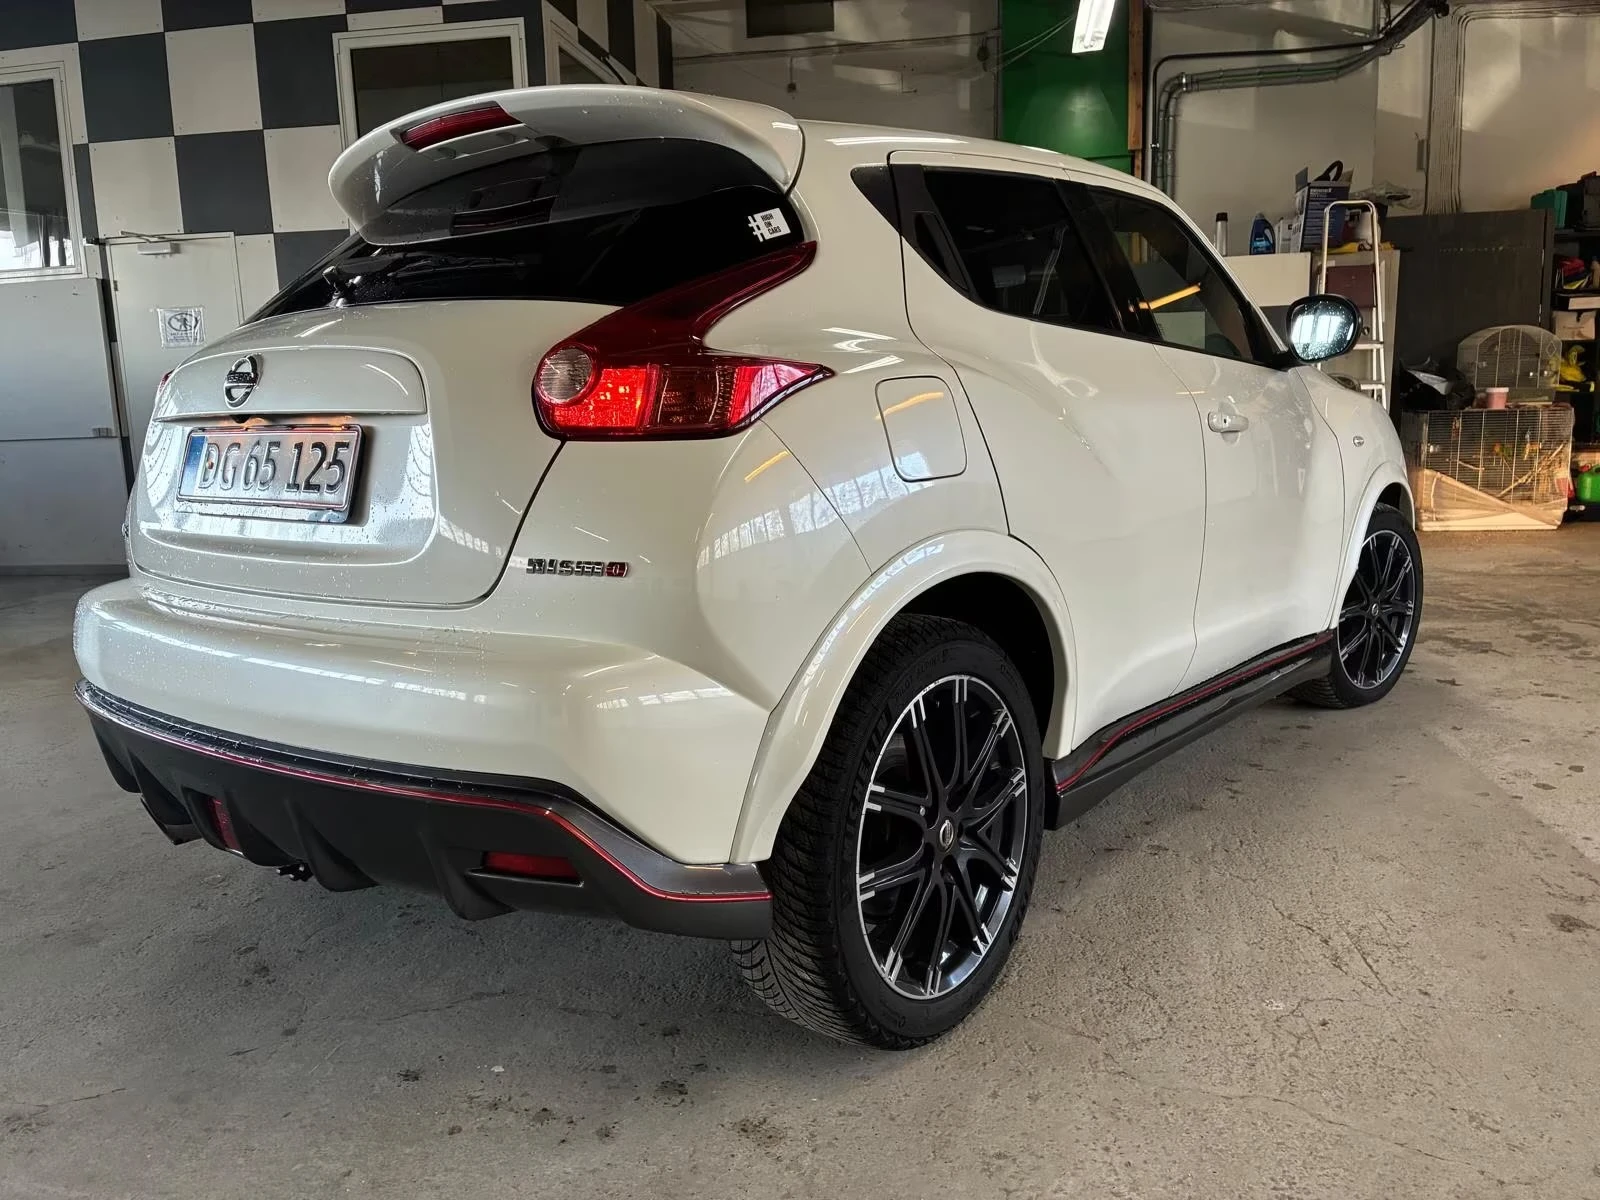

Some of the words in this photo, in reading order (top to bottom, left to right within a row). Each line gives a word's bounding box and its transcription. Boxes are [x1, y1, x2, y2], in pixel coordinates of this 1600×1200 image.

[768, 226, 781, 234] CARS
[197, 442, 241, 491] DG
[242, 440, 281, 491] 65
[284, 441, 350, 494] 125
